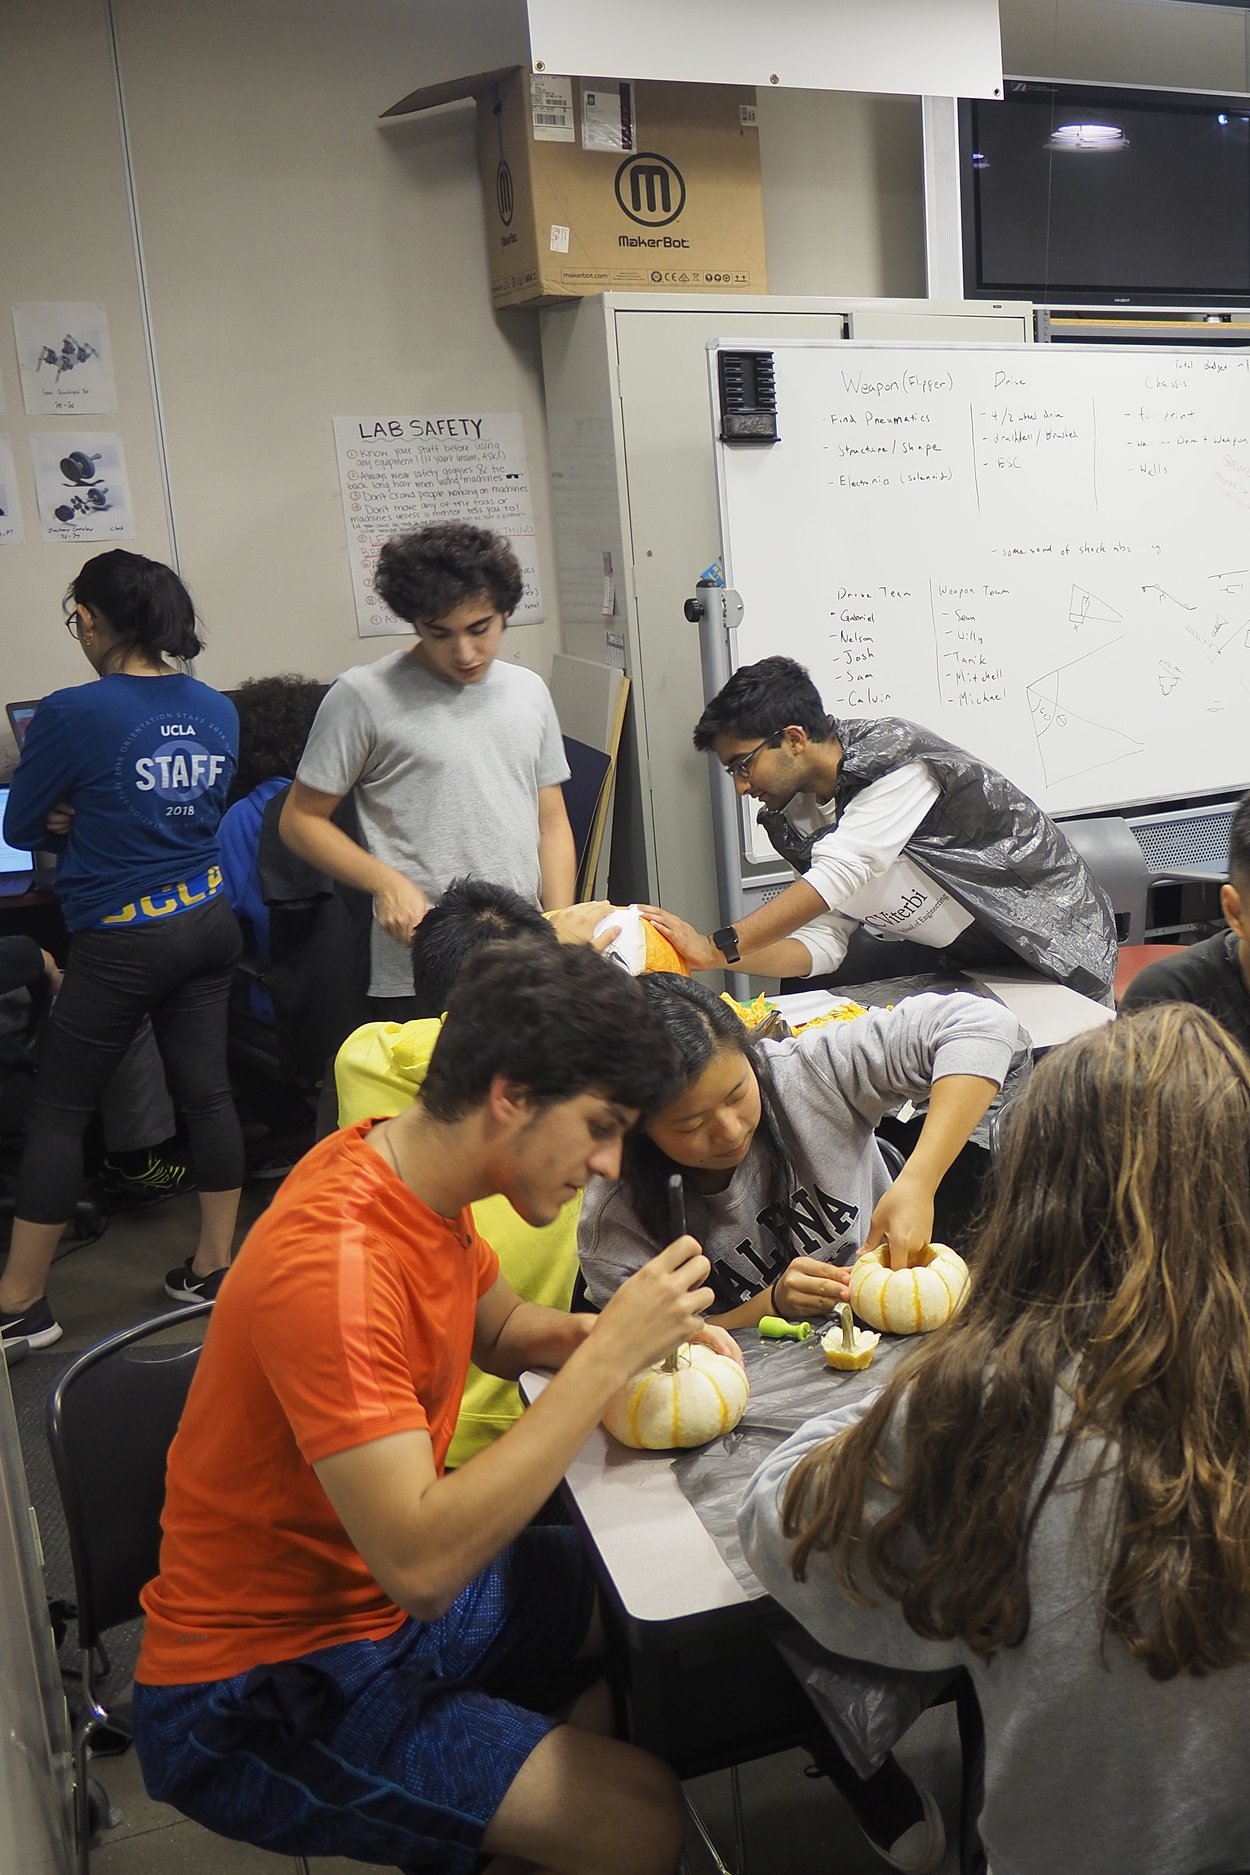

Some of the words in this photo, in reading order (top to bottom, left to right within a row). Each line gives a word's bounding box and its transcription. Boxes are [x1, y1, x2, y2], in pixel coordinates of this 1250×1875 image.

[618, 236, 690, 248] MakerBot
[563, 271, 608, 280] makerbot.com
[994, 371, 1026, 389] Drive
[1145, 376, 1188, 389] Chassis
[831, 413, 857, 425] Find
[865, 411, 931, 426] Pneumatics
[359, 421, 404, 439] LAB
[410, 419, 482, 439] SAFETY
[1214, 435, 1248, 446] Weapon
[360, 449, 388, 458] Know
[394, 448, 411, 459] your
[444, 444, 470, 452] before
[475, 443, 500, 452] using
[902, 442, 942, 456] Shape
[357, 460, 372, 470] any
[998, 456, 1021, 468] ESC
[360, 471, 387, 481] Always
[391, 470, 409, 479] wear
[413, 467, 439, 480] safety
[443, 466, 473, 478] goggles
[492, 465, 505, 474] tie
[347, 481, 368, 489] back
[372, 481, 390, 492] long
[394, 480, 412, 488] hair
[415, 479, 434, 488] when
[438, 477, 459, 489] using
[463, 474, 503, 483] machines
[363, 491, 387, 501] Don't
[419, 490, 445, 502] people
[449, 489, 478, 499] working
[492, 485, 528, 493] machines
[350, 513, 392, 523] machines
[396, 511, 420, 520] unless
[433, 509, 462, 517] mentor
[467, 506, 483, 514] tells
[486, 506, 500, 515] you
[504, 504, 519, 512] to!
[365, 504, 389, 514] Don't
[422, 502, 437, 511] any
[1003, 547, 1025, 556] some
[1061, 548, 1070, 556] of
[1079, 542, 1106, 554] shock
[837, 588, 872, 600] Drive
[878, 587, 911, 598] Team
[939, 585, 975, 599] Weapon
[982, 585, 1010, 596] Team
[840, 609, 875, 623] Gabriel
[954, 608, 976, 622] Sean
[840, 630, 874, 643] Nelson
[957, 630, 984, 644] Willy
[843, 647, 875, 665] Josh
[846, 670, 874, 682] Sam
[956, 668, 1002, 686] Mitchell
[848, 688, 891, 707] Calvin
[959, 689, 1006, 707] Michael
[160, 725, 196, 736] UCLA
[135, 754, 225, 791] STAFF
[166, 805, 195, 816] 2018
[919, 893, 950, 925] Engineering
